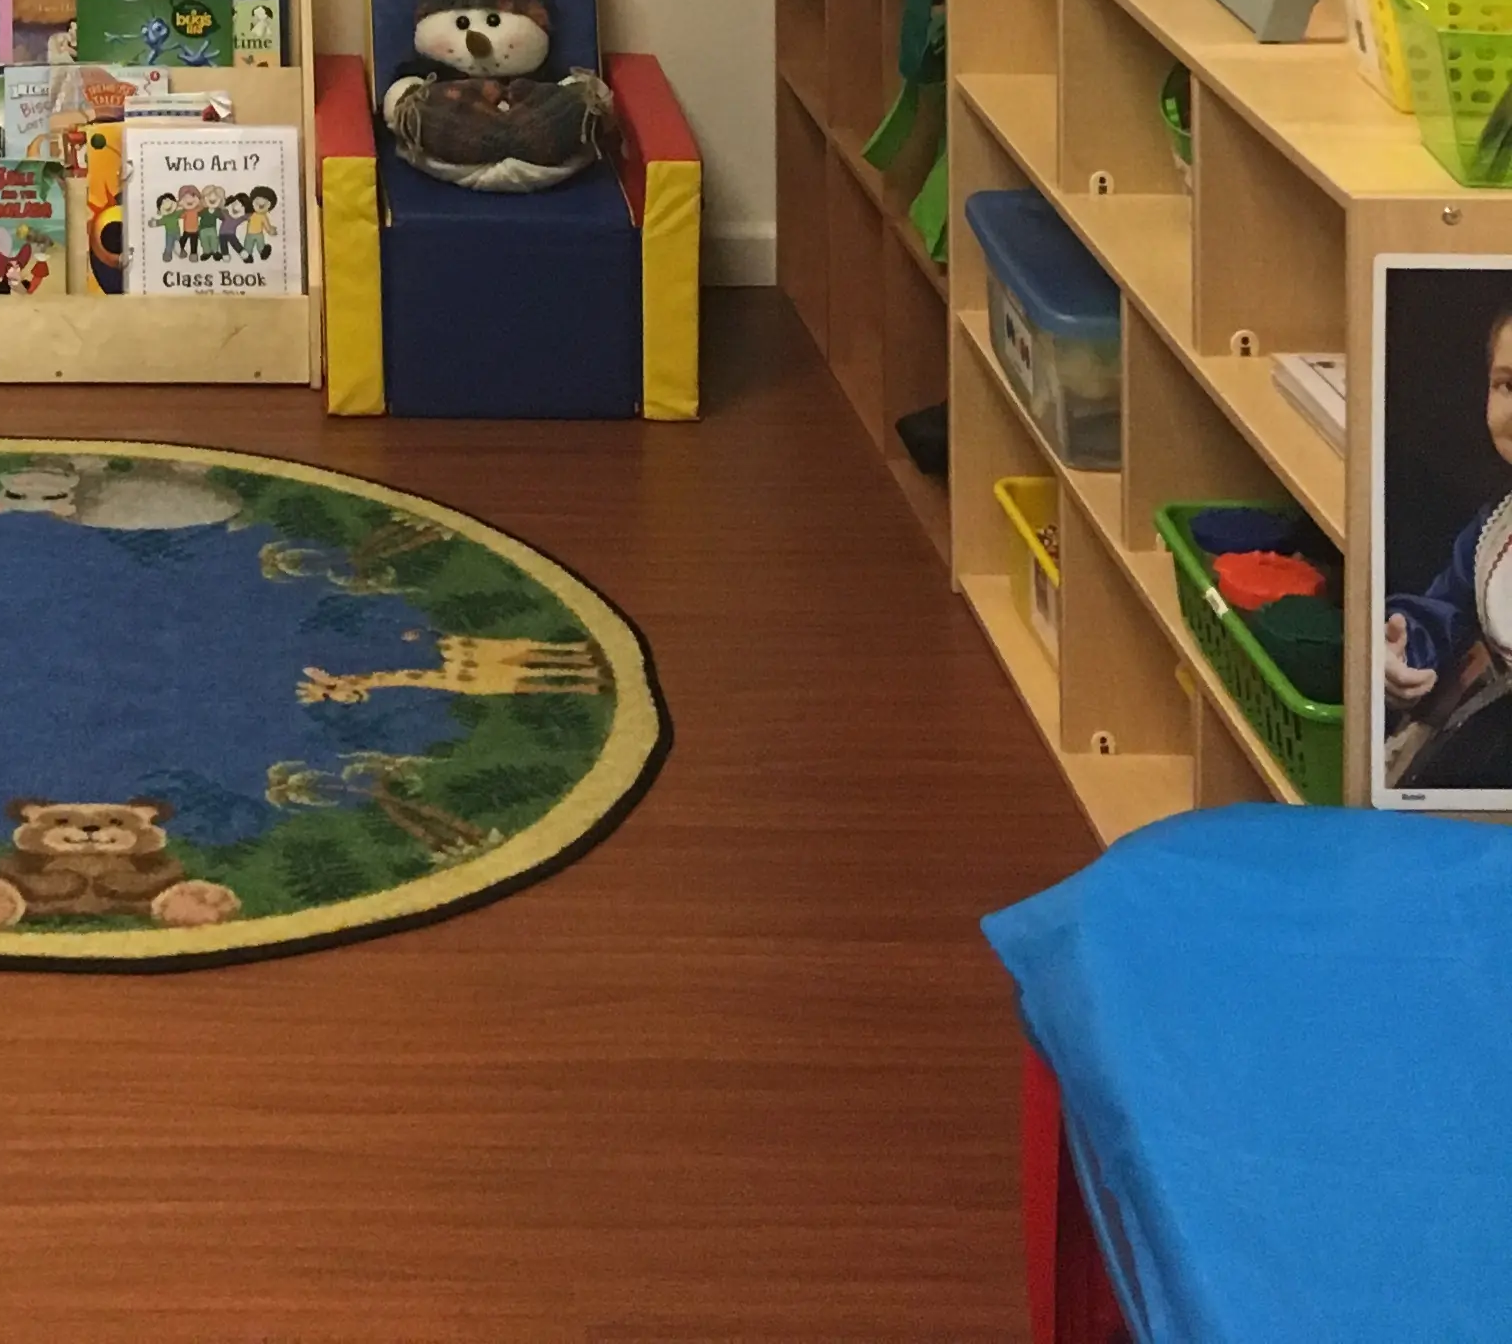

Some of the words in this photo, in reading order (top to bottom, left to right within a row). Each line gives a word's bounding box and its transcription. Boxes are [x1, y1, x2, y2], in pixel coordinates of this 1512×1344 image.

[165, 155, 204, 172] Who
[211, 157, 237, 172] Am
[244, 154, 260, 171] I?
[163, 272, 213, 288] Class
[221, 271, 266, 287] Book
